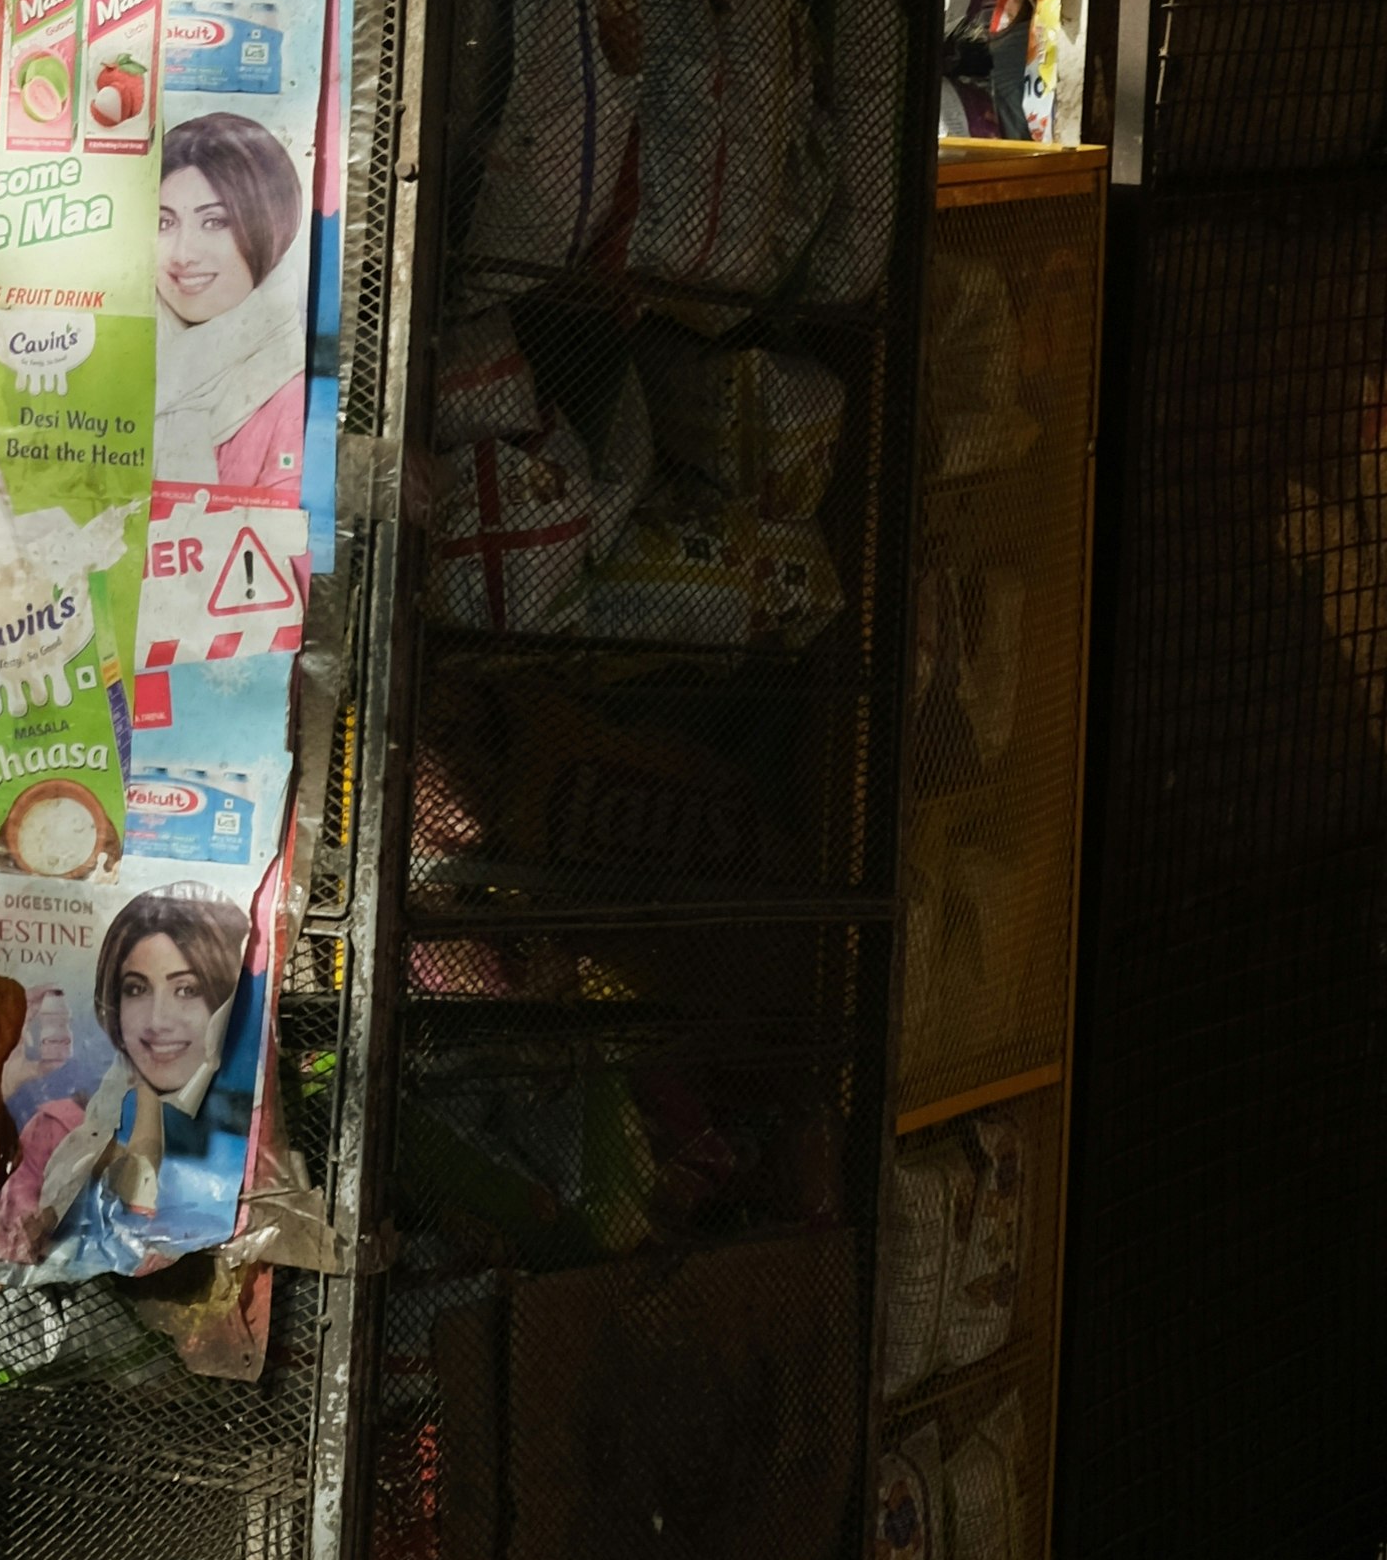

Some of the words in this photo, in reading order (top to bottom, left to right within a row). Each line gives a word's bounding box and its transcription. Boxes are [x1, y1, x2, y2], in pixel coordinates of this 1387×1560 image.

[45, 16, 74, 37] Guava
[20, 195, 112, 245] Maa
[6, 287, 52, 307] FRUIT
[54, 290, 106, 309] DRINK
[9, 326, 78, 355] Cavin's
[20, 406, 59, 428] Desi
[66, 409, 108, 438] Way
[115, 416, 136, 434] to
[6, 438, 49, 460] Beat
[56, 442, 85, 463] the
[92, 445, 145, 467] Heat!
[14, 718, 70, 741] MASALA
[4, 893, 94, 915] DIGESTION
[21, 948, 58, 966] DAY
